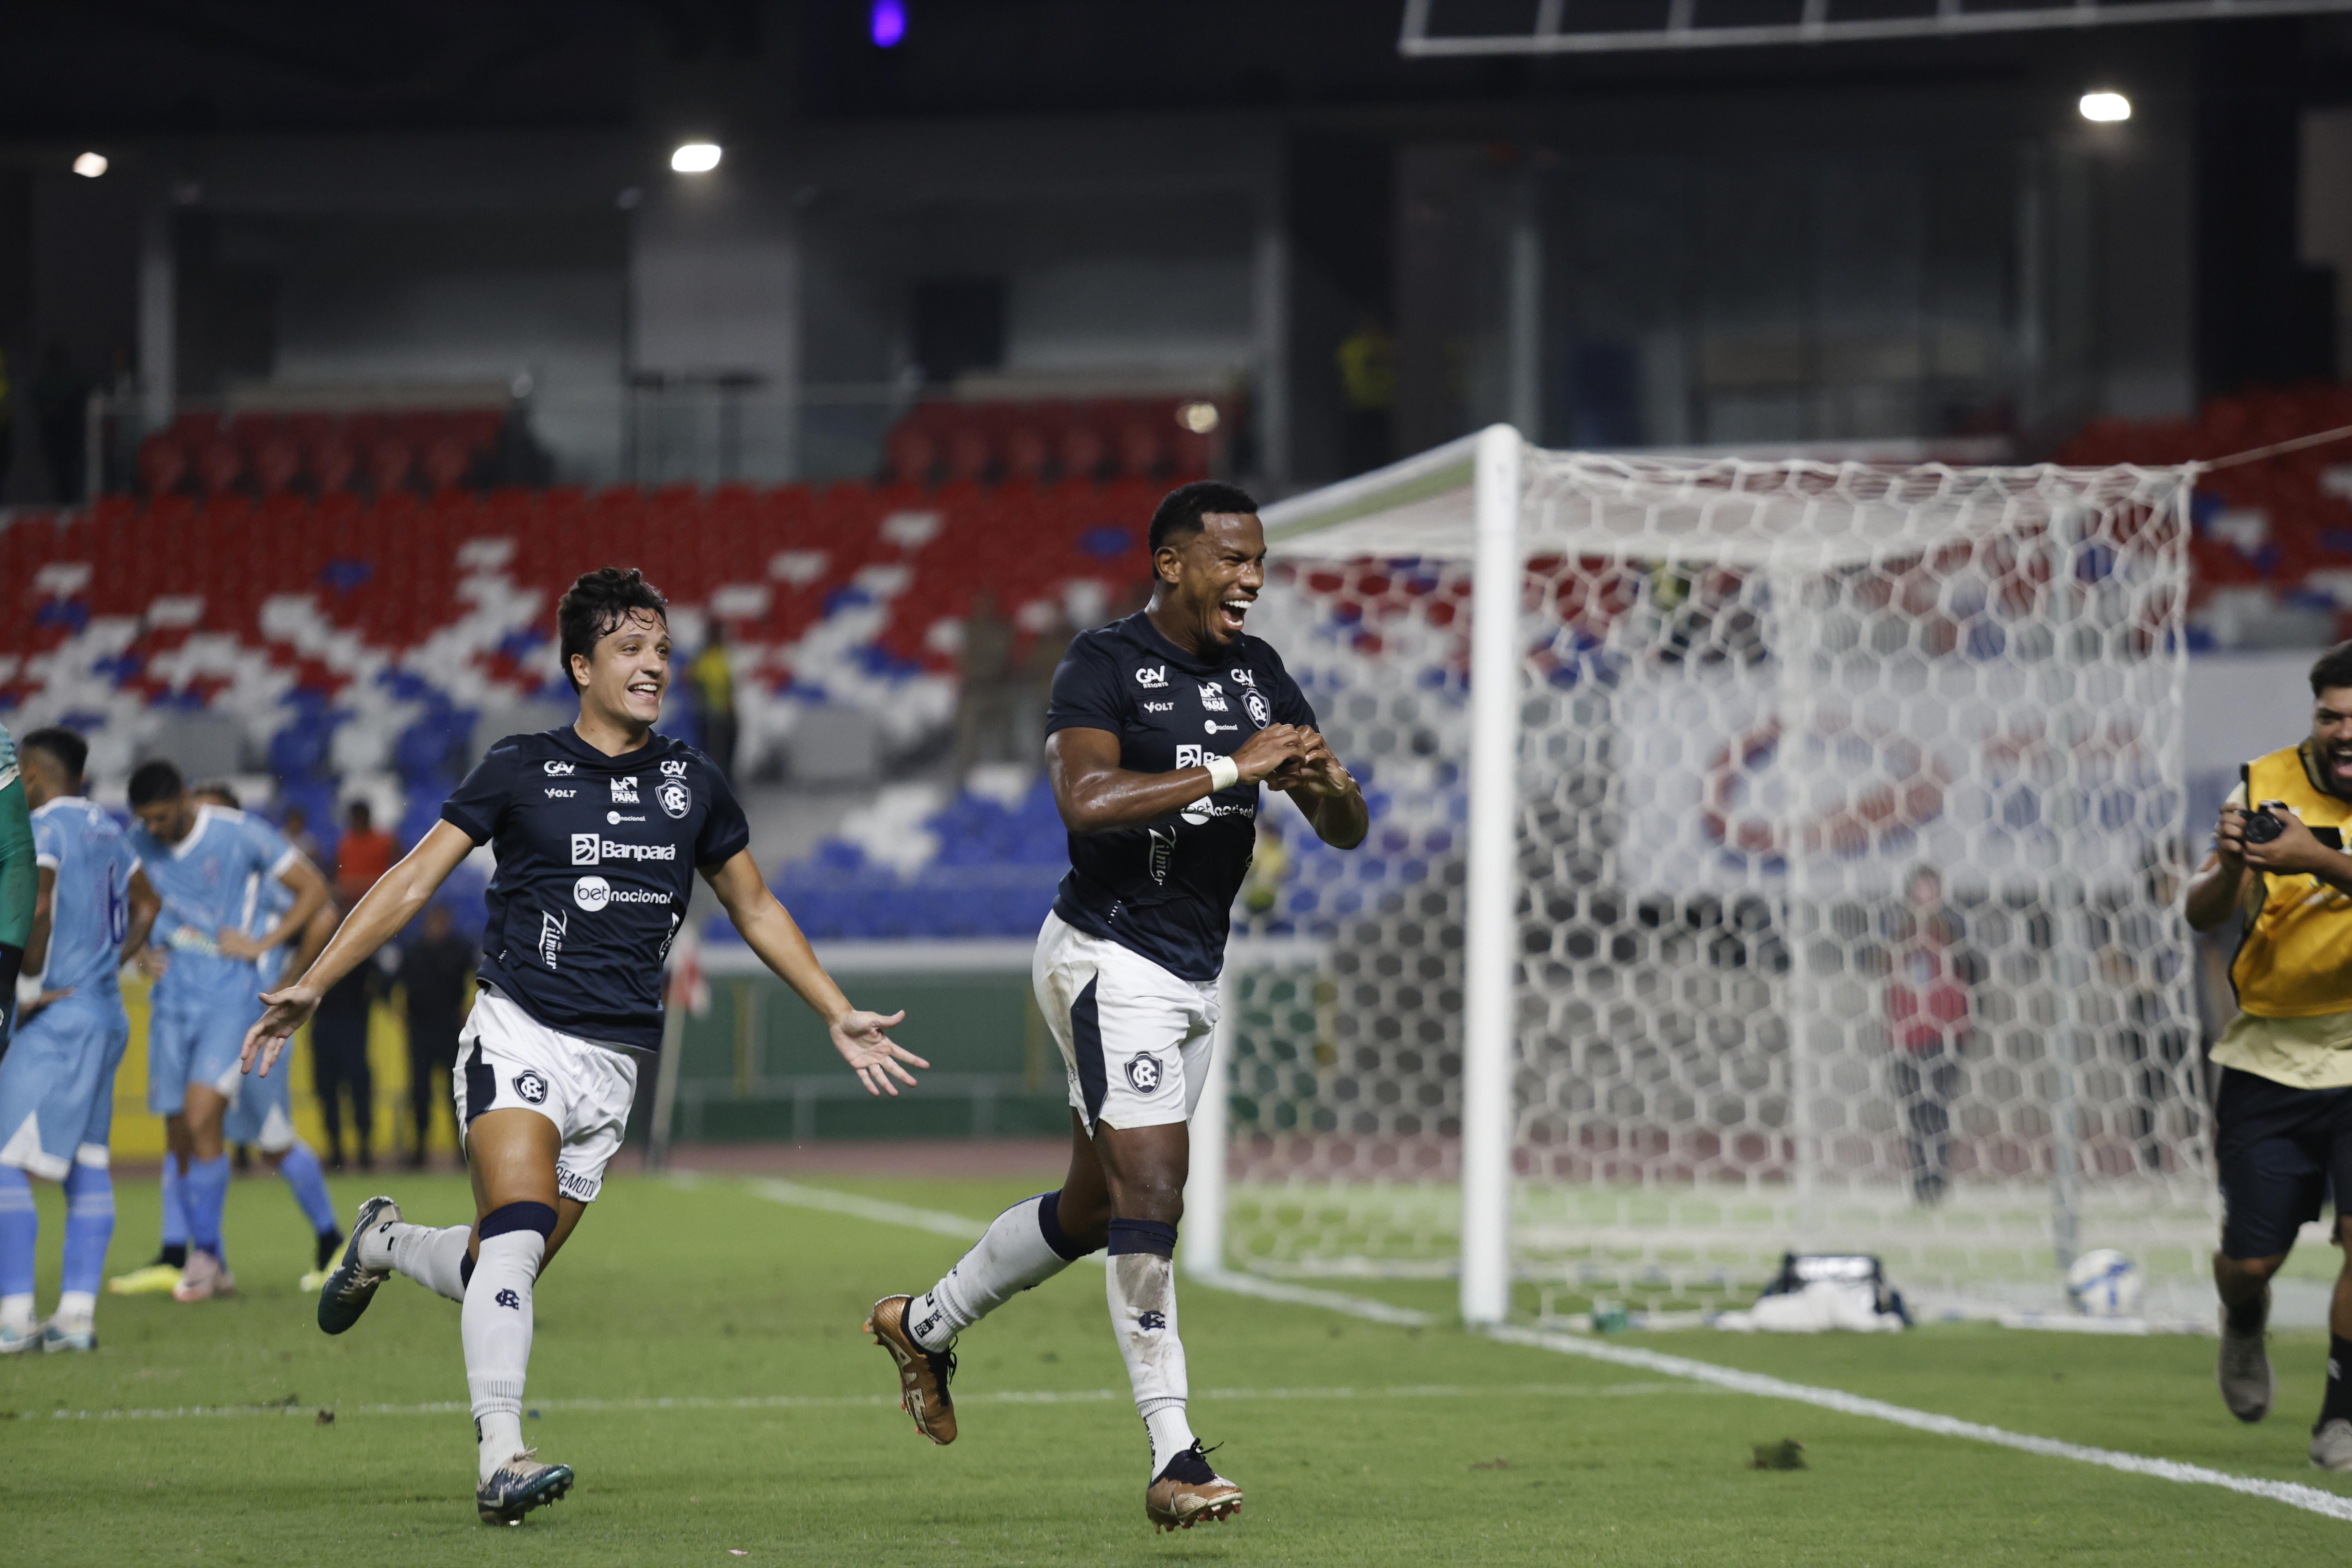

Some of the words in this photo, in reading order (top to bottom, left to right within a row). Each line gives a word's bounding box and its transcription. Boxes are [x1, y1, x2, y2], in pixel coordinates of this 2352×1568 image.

[1136, 665, 1165, 684] GAV
[1144, 702, 1174, 713] VOLT
[544, 760, 576, 774] GAV
[660, 760, 687, 775] GAV
[544, 788, 577, 799] VOLT
[602, 841, 675, 862] Banpará
[1148, 825, 1176, 886] Zilmar
[539, 909, 567, 969] Zilmar
